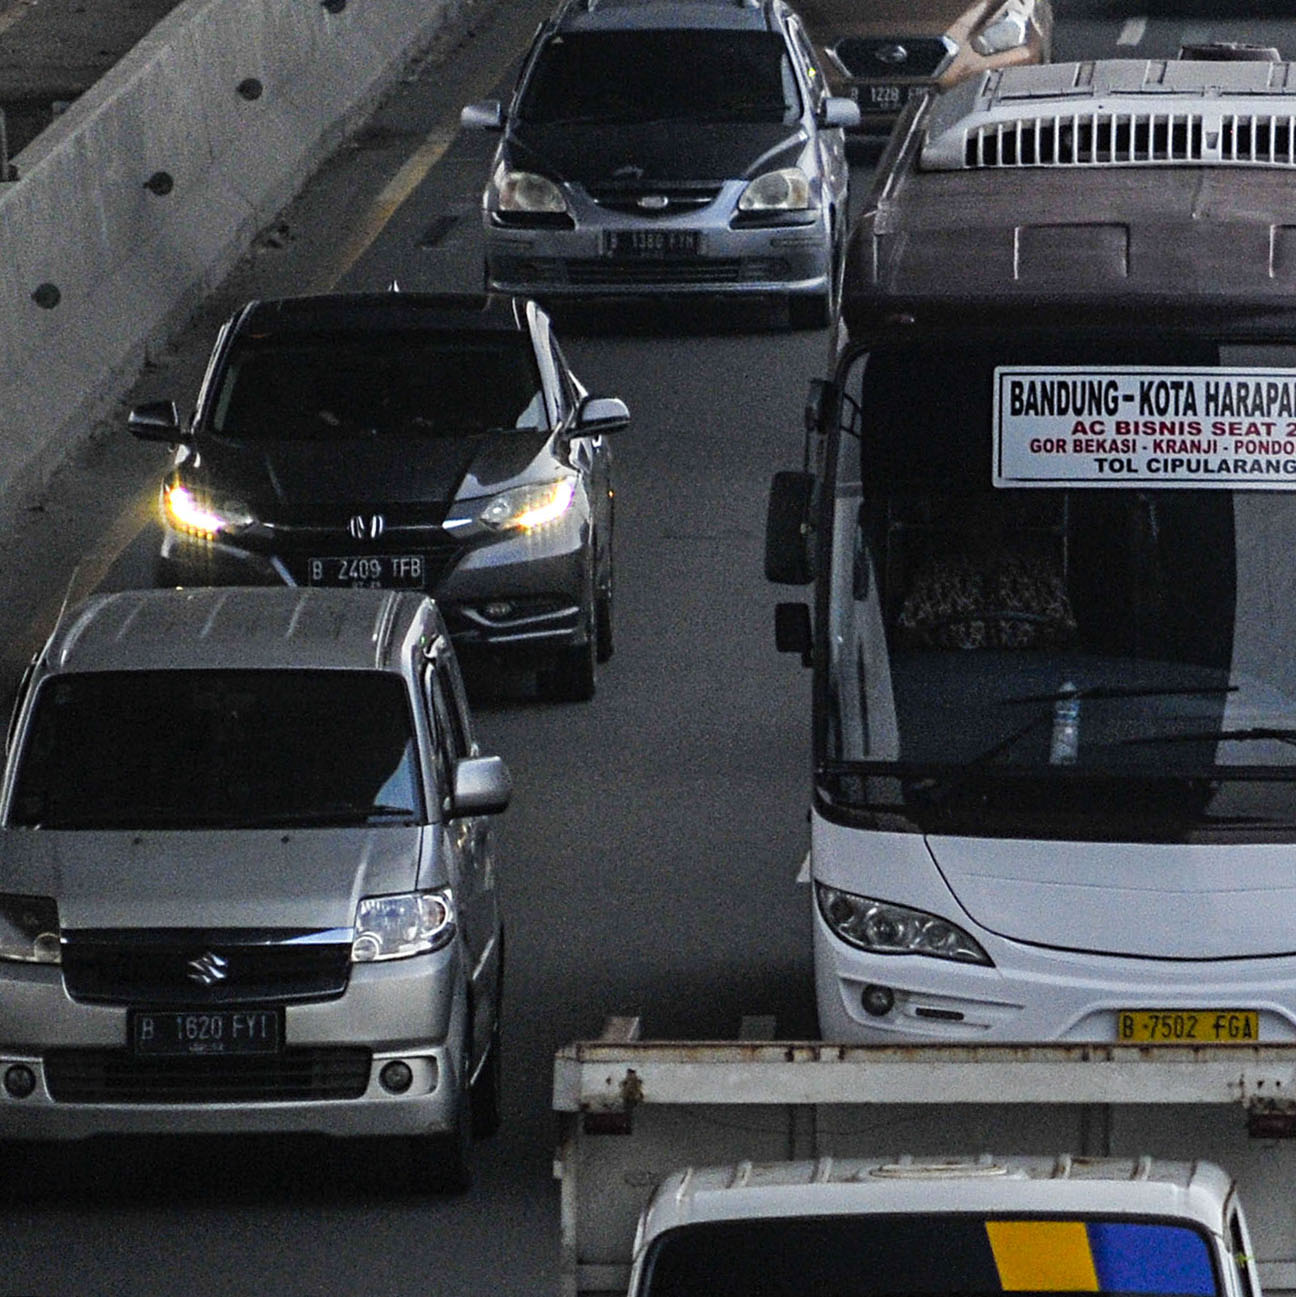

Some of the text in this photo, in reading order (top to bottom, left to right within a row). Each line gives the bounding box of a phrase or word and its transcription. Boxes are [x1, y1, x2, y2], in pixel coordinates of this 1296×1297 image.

[1071, 421, 1106, 436] AC
[1115, 421, 1203, 436] BISNIS
[1211, 422, 1277, 437] SEAT
[1030, 438, 1067, 454] GOR
[1073, 439, 1137, 454] BEKASI
[1153, 439, 1218, 455] KRANJI
[1094, 458, 1139, 473] TOL
[313, 557, 421, 581] B 2409 TFB
[141, 1017, 154, 1040] B
[176, 1015, 223, 1040] 1620
[1122, 1014, 1252, 1039] B 7502 FGA
